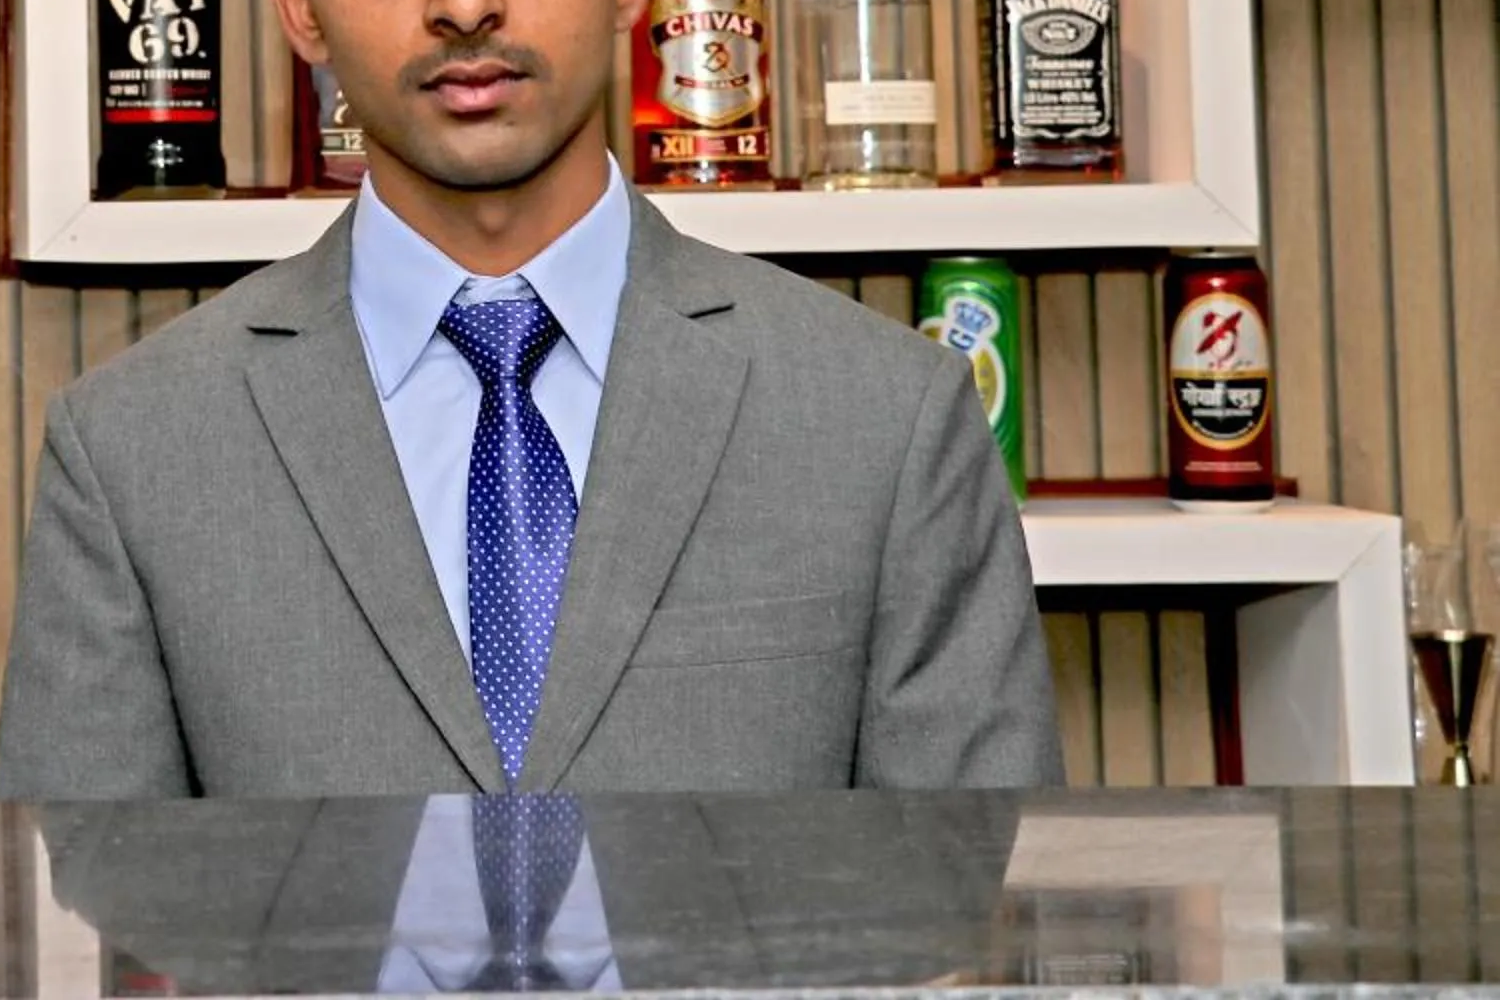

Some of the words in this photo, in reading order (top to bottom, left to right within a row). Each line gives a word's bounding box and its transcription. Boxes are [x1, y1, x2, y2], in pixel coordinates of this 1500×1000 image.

[665, 12, 754, 37] CHIVAS
[343, 132, 363, 151] 12
[661, 135, 694, 156] XII
[737, 135, 757, 155] 12
